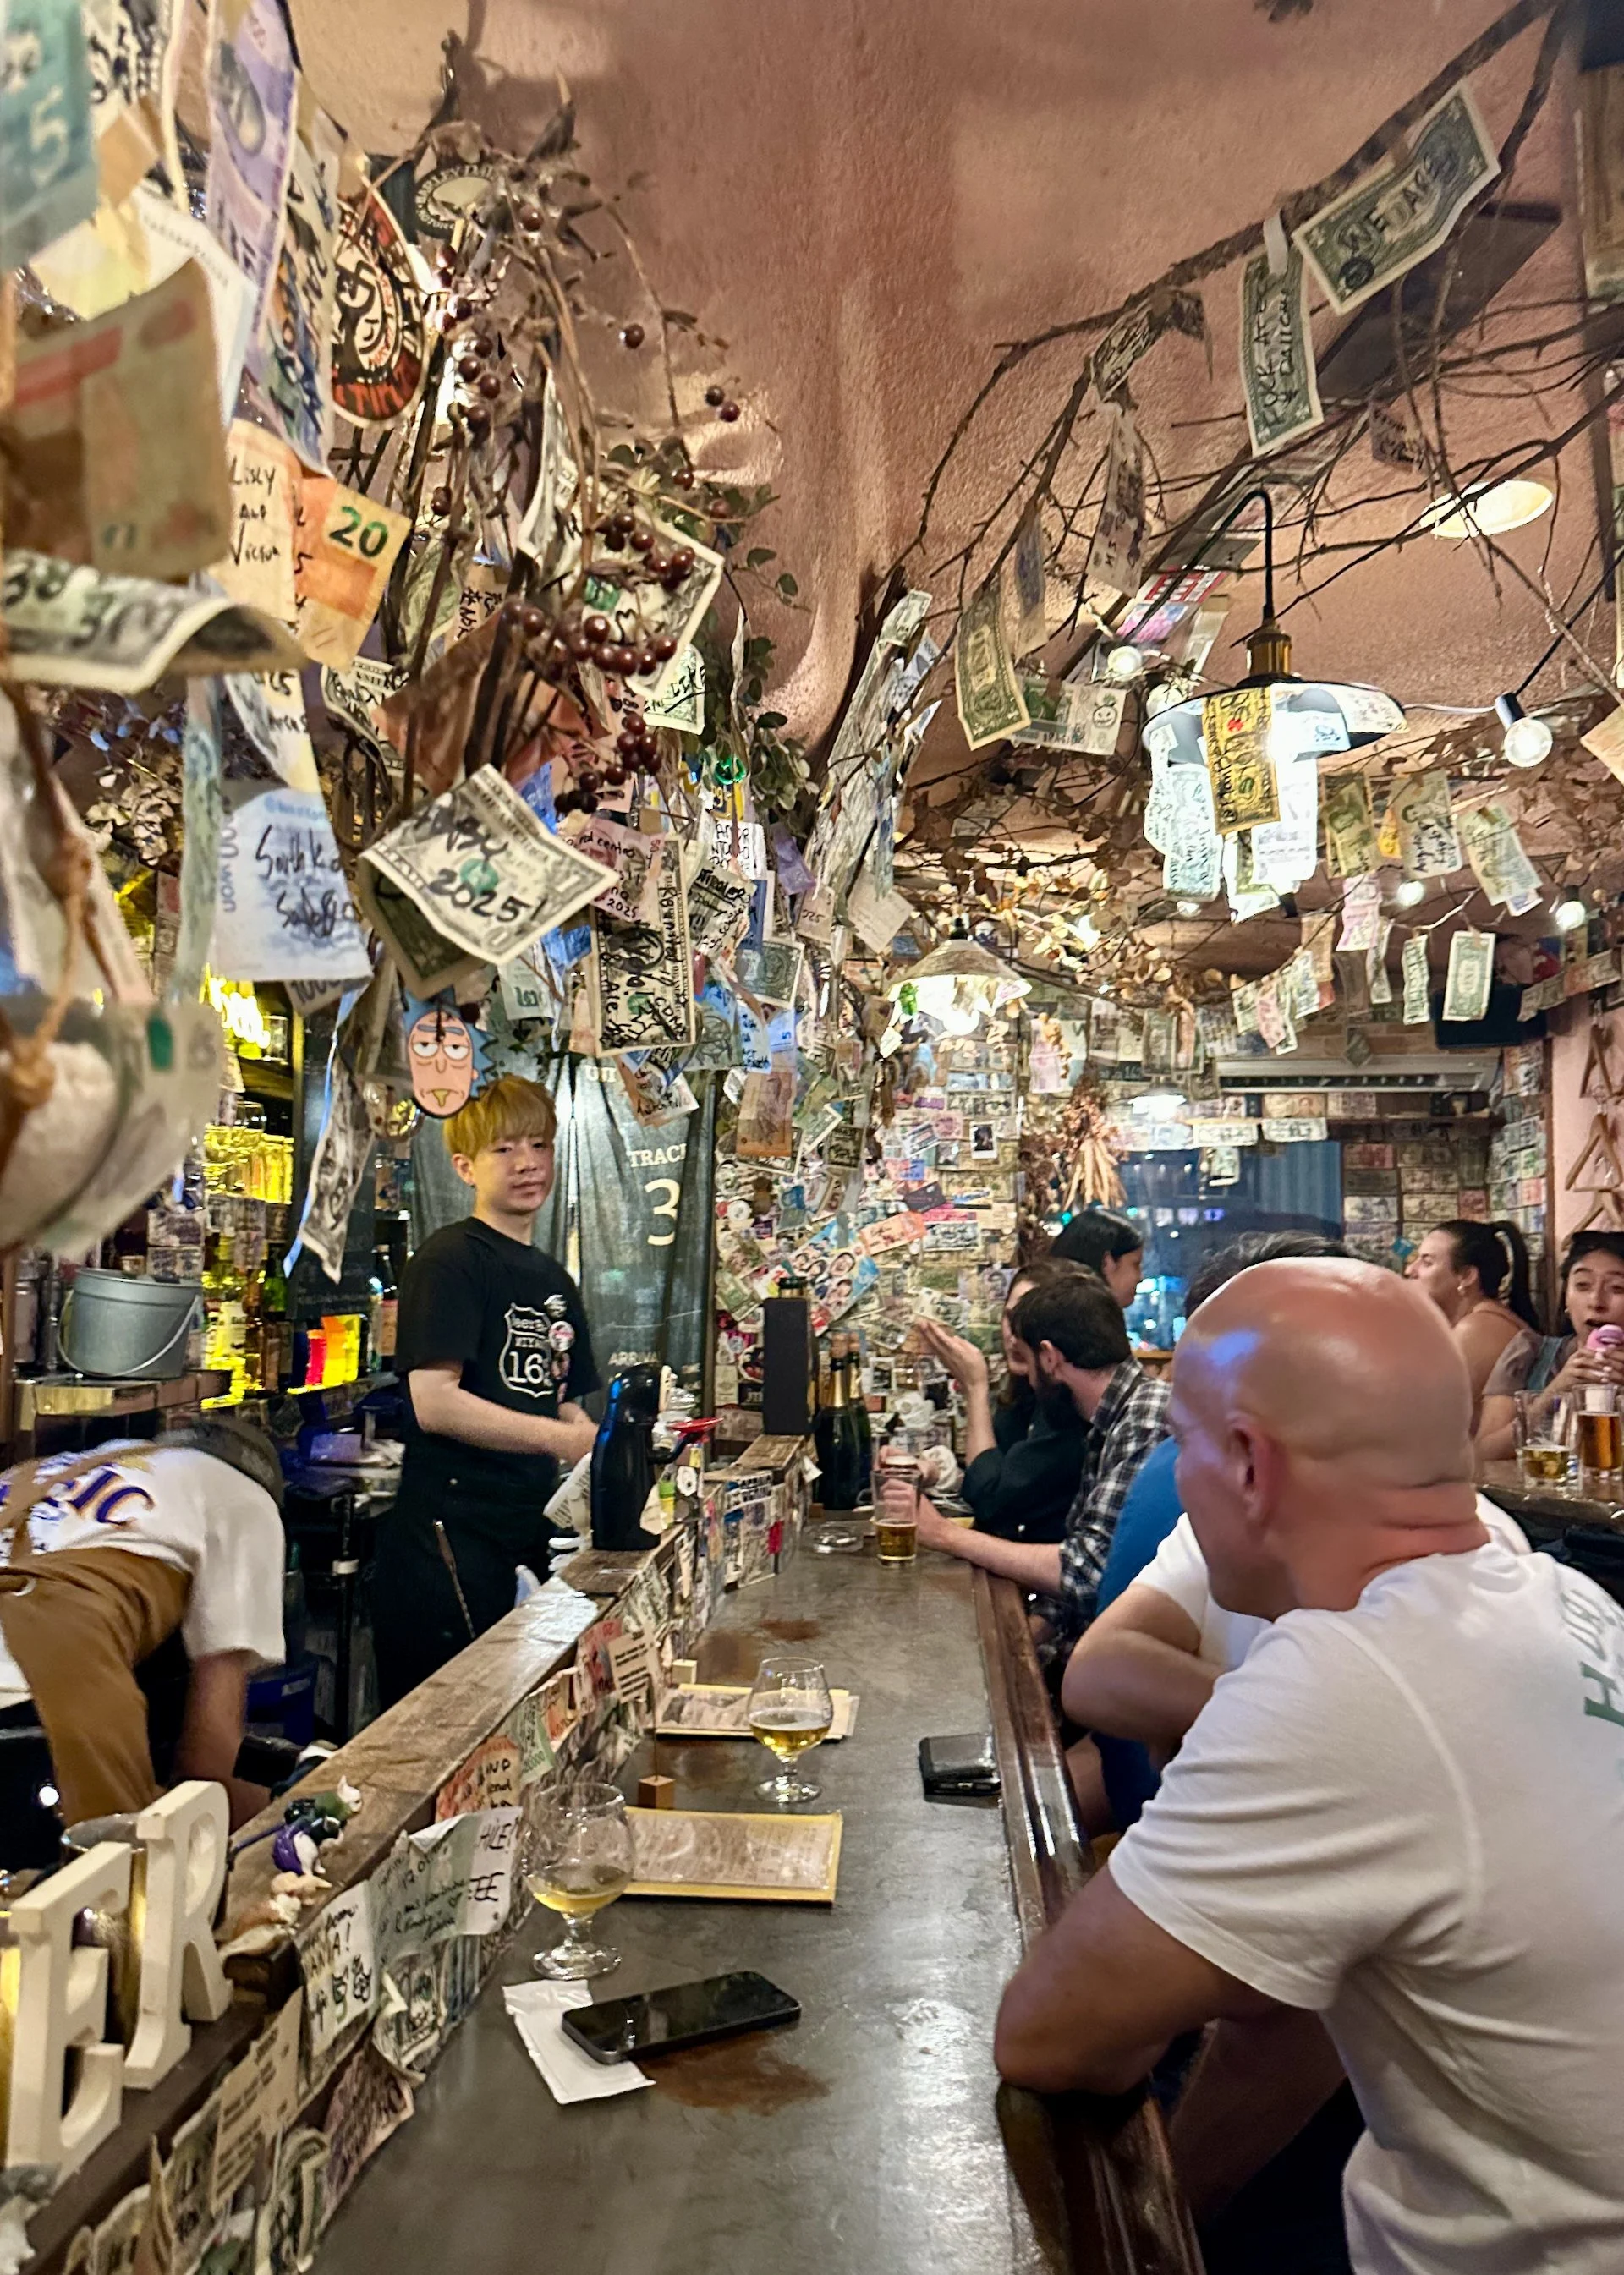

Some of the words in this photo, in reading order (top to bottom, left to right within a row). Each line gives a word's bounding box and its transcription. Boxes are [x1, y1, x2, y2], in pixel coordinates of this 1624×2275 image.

[329, 505, 389, 559] 20
[606, 897, 639, 918] 2025
[644, 1177, 681, 1247] 3
